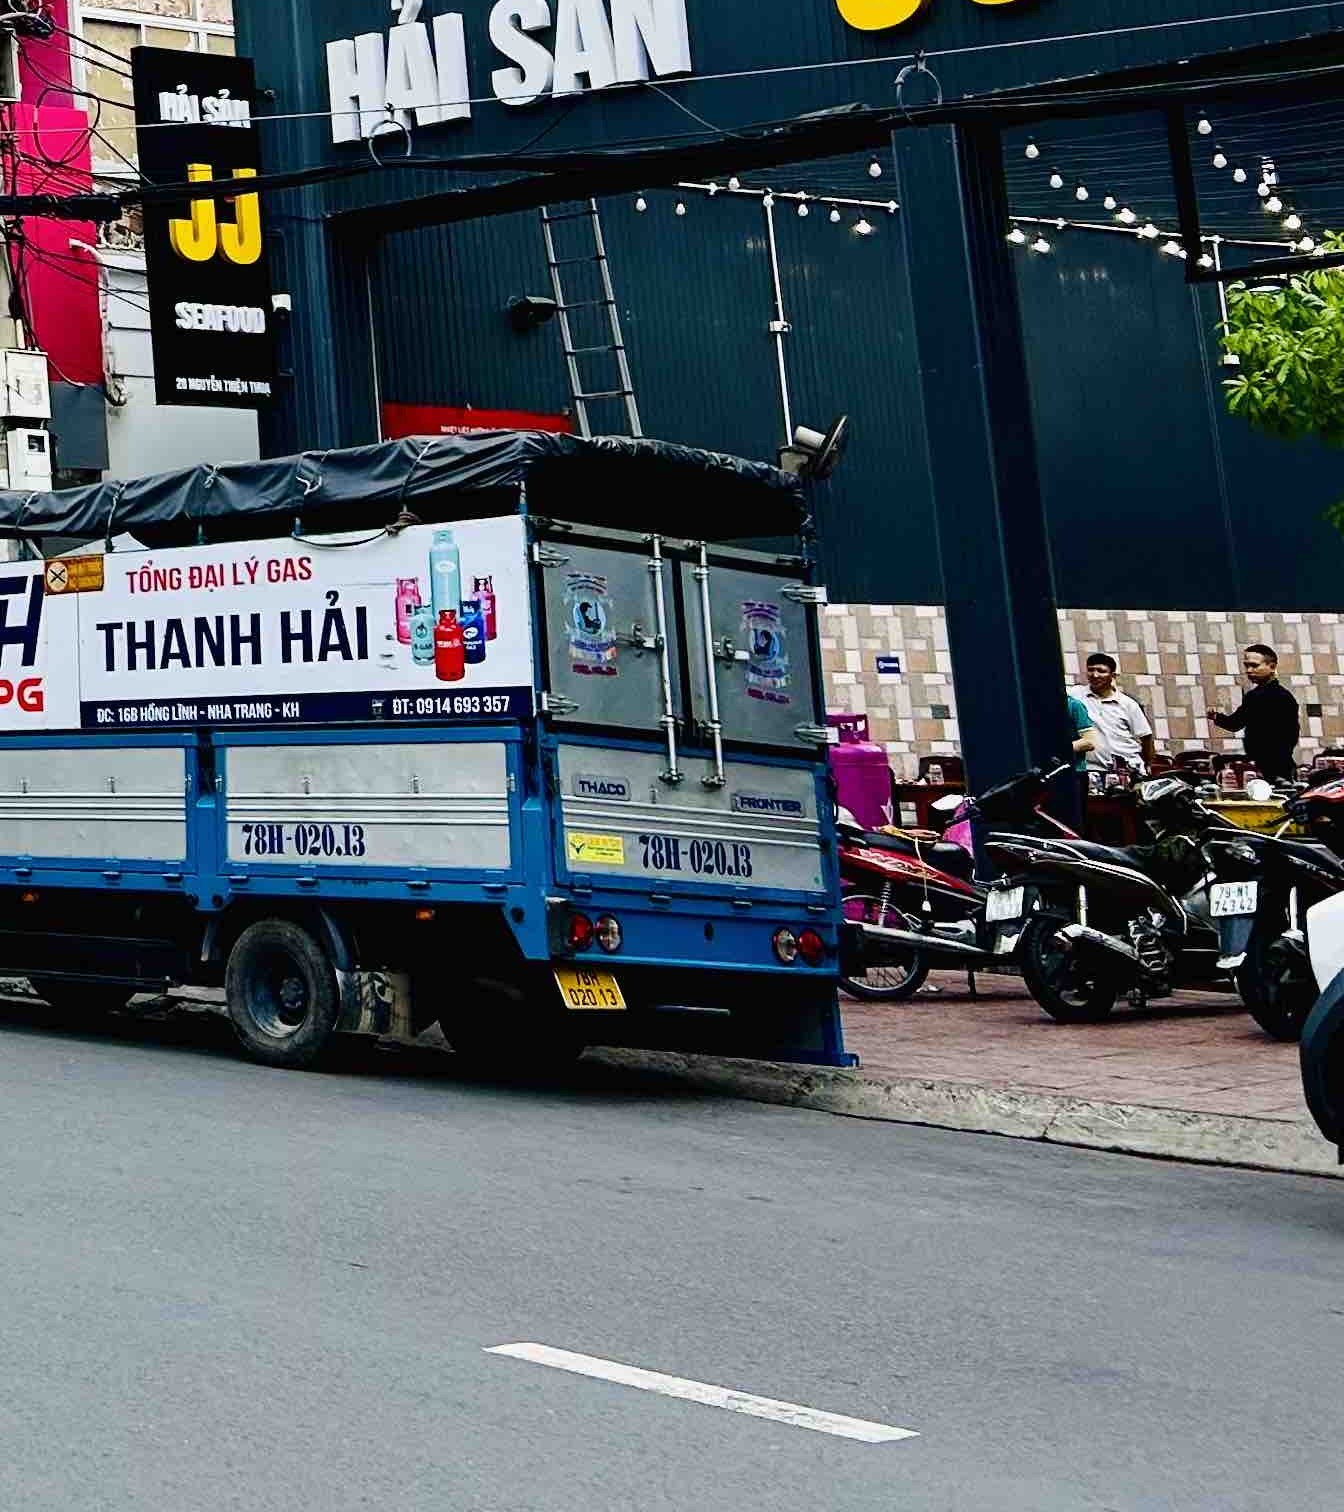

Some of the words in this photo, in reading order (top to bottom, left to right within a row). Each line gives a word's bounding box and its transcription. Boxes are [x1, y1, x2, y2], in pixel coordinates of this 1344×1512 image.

[159, 84, 200, 123] HẢI
[202, 89, 251, 128] SẢN
[169, 163, 262, 264] JJ
[175, 302, 265, 333] SEAFOOD
[126, 559, 182, 594] TỔNG
[188, 563, 224, 593] ĐẠI
[232, 556, 259, 586] LÝ
[267, 556, 312, 584] GAS
[96, 612, 262, 672] THANH
[280, 590, 369, 664] HẢI
[97, 707, 115, 723] ĐC:
[118, 706, 138, 722] 16B
[140, 701, 170, 722] HỒNG
[171, 701, 198, 721] LĨNH
[207, 704, 232, 720] NHA
[233, 703, 273, 719] TRANG
[282, 701, 300, 719] KH
[392, 697, 414, 715] ĐT:
[416, 697, 452, 714] 0914
[454, 696, 480, 713] 693
[482, 695, 511, 712] 357
[578, 779, 627, 796] THACO
[739, 796, 802, 813] FRONTIER
[242, 823, 366, 857] 78H-020.13
[638, 835, 753, 878] 78H-020.13
